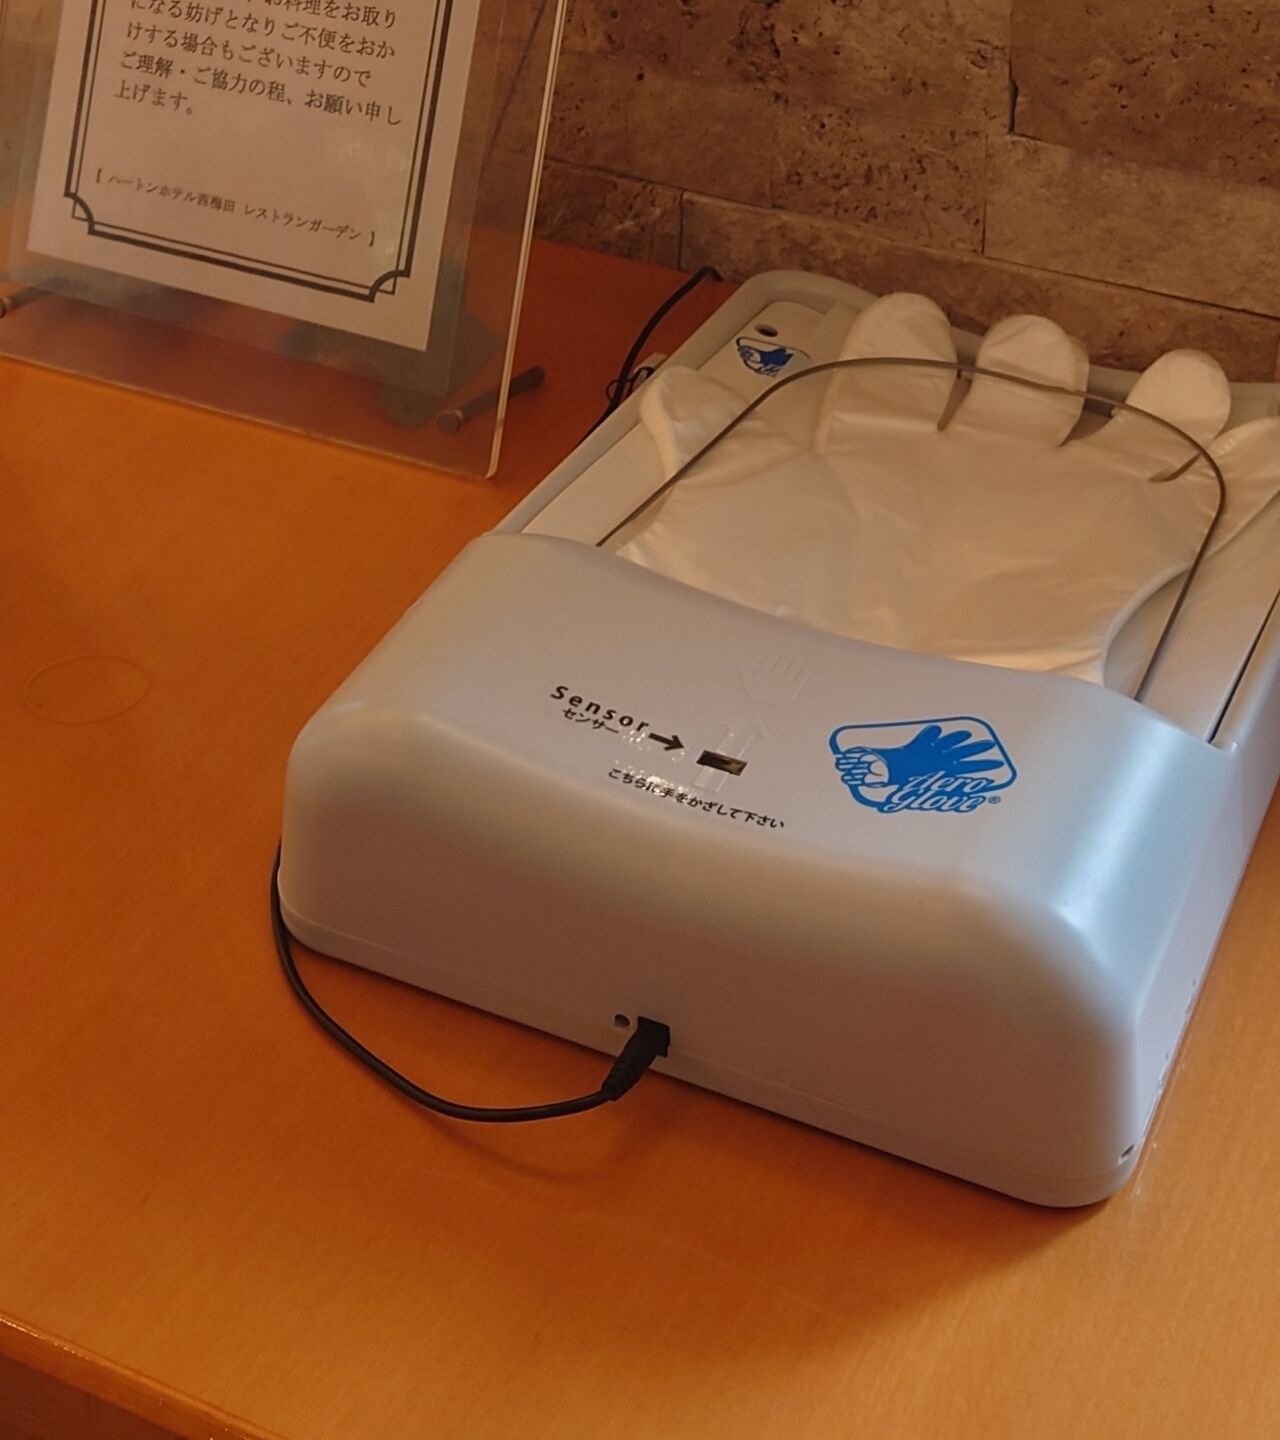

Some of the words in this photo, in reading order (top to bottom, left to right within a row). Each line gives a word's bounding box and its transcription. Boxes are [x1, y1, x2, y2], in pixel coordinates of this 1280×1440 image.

[127, 21, 372, 88] けする場合もございますので
[114, 80, 193, 115] 上げます。
[120, 50, 402, 126] ご理解・ご協力の程、お願い申し
[550, 685, 650, 732] Sensor
[562, 707, 619, 734] センサー
[607, 767, 785, 829] こちらに手をかざして下さい
[903, 770, 993, 793] Aero
